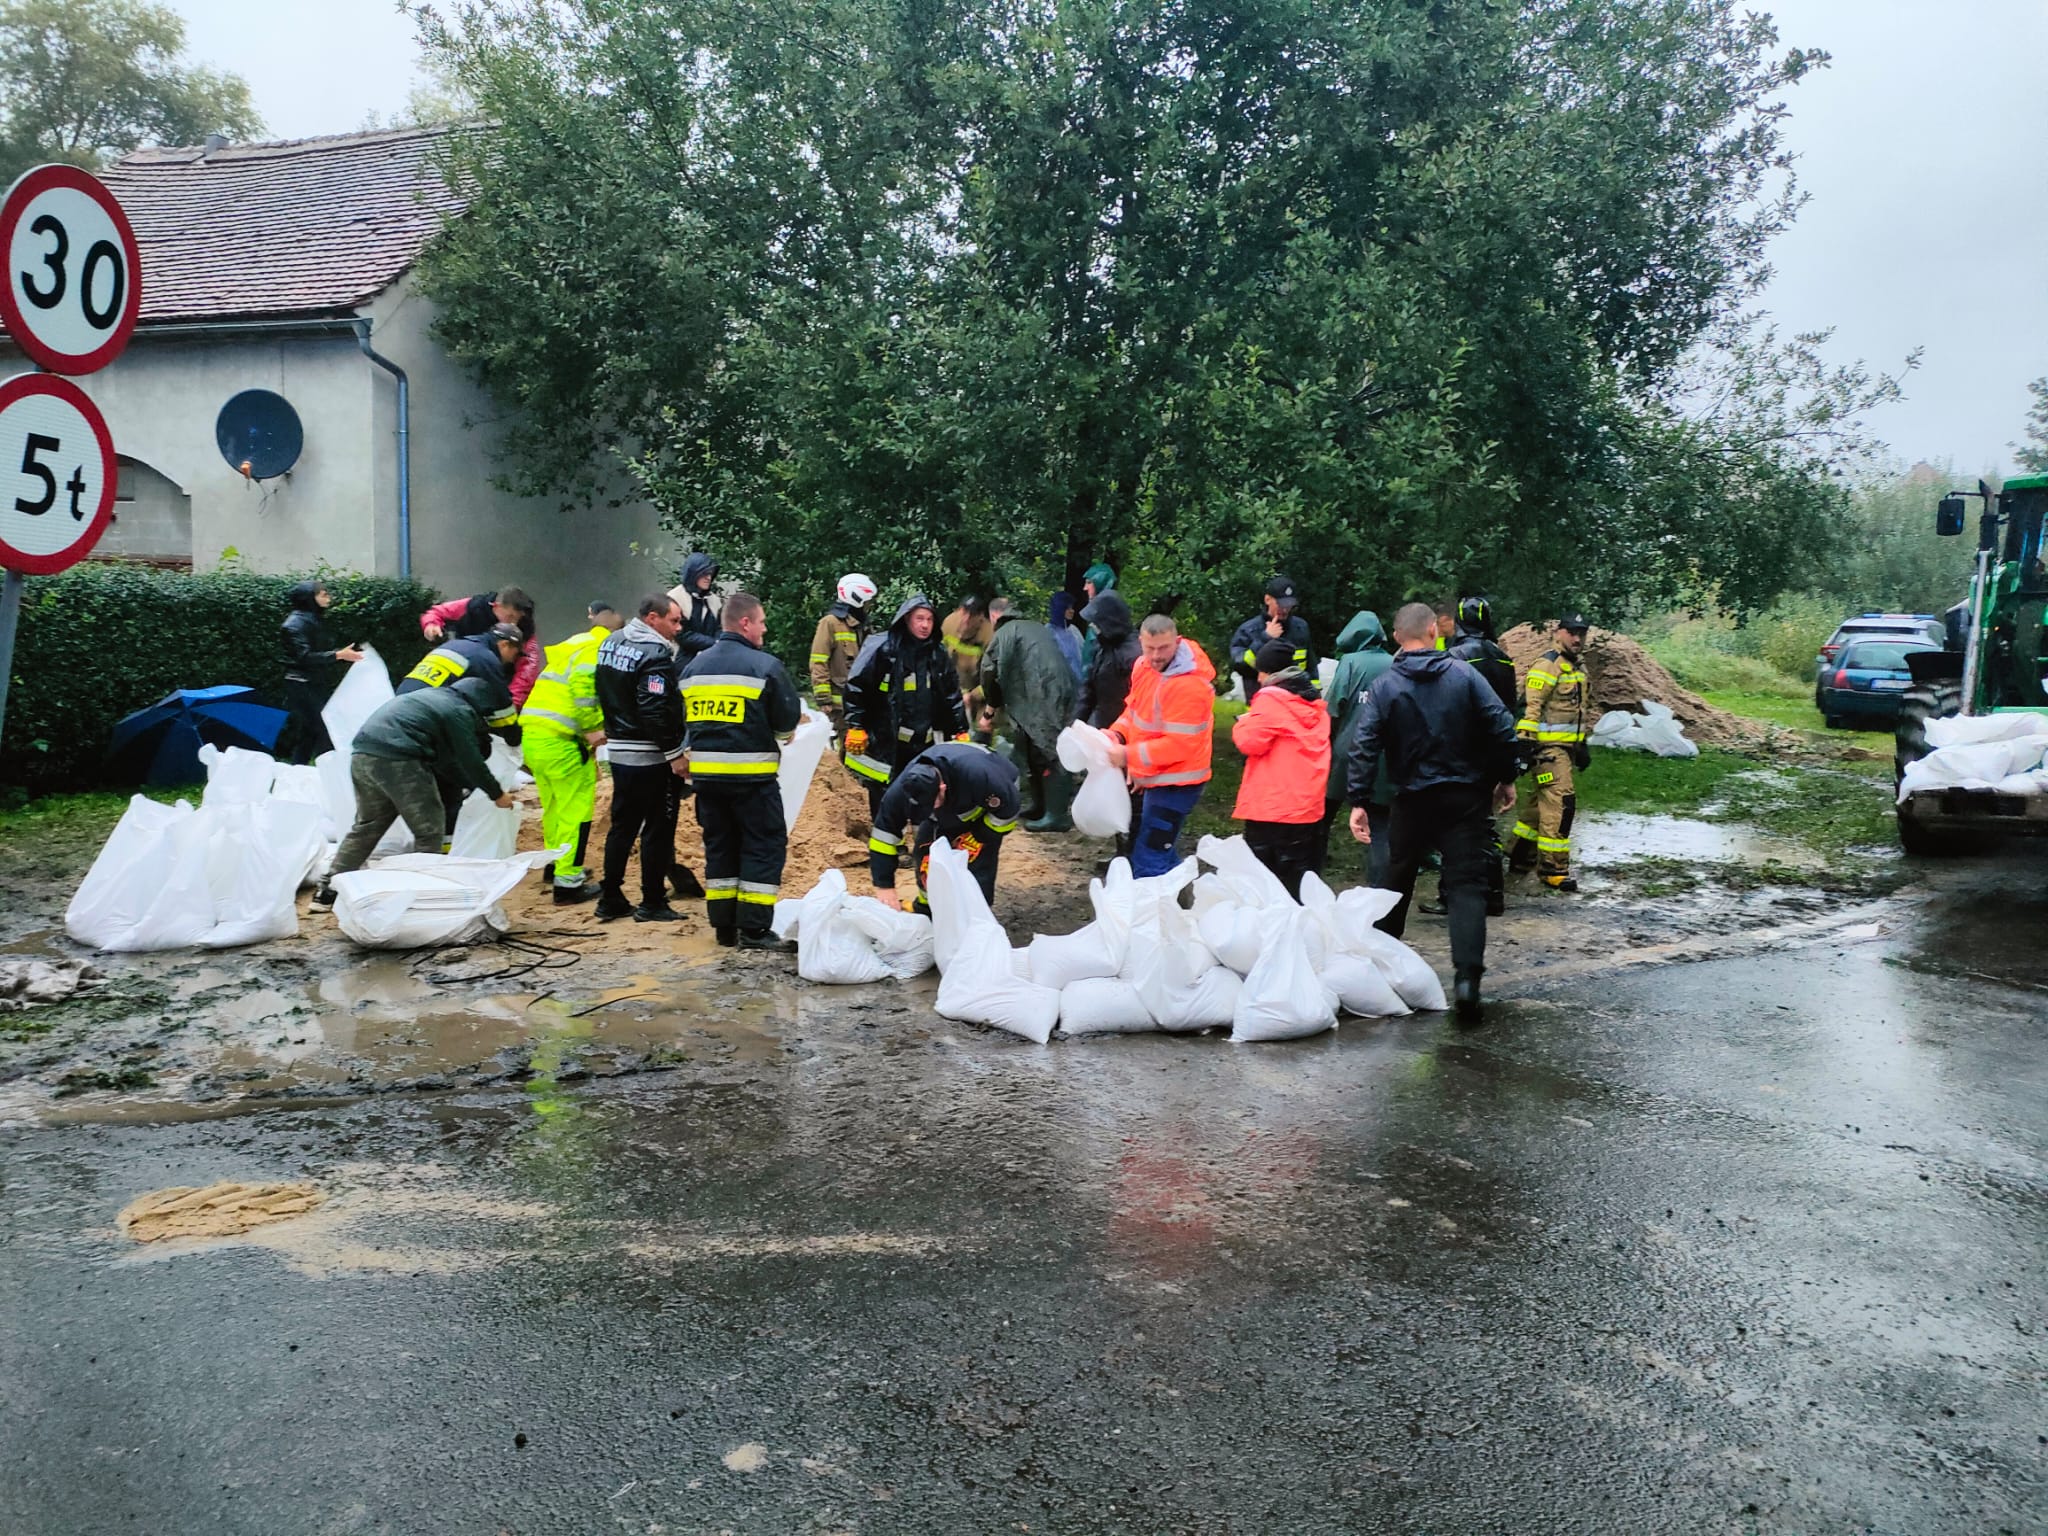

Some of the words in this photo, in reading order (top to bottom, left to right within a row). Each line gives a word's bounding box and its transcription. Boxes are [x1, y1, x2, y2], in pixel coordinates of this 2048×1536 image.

[21, 214, 125, 330] 30
[600, 641, 616, 653] LAS
[597, 651, 636, 672] RAERS
